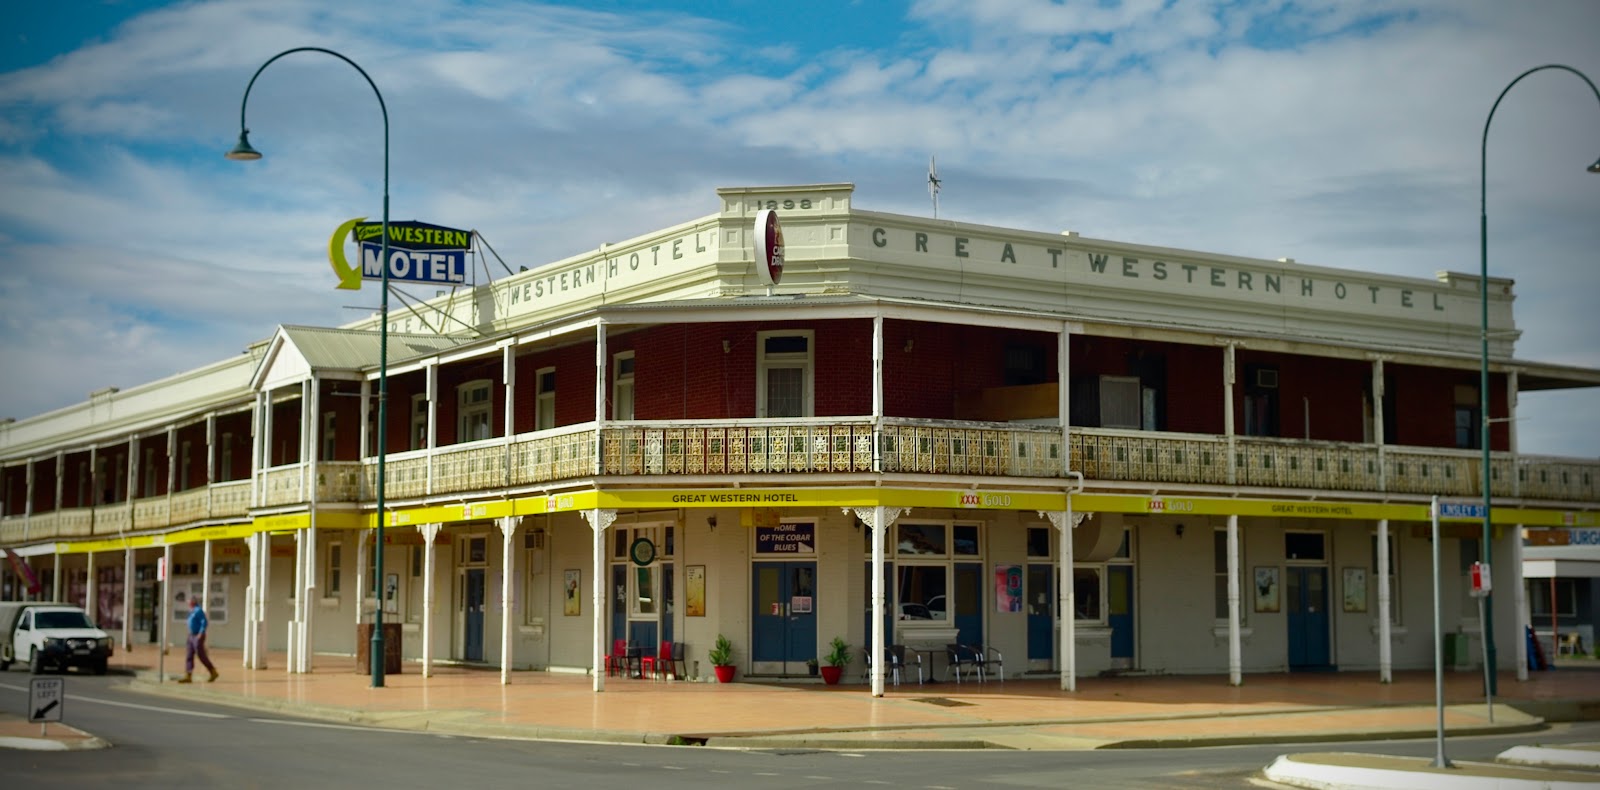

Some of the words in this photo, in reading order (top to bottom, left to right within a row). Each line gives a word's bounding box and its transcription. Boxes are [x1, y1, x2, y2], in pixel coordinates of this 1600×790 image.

[757, 199, 813, 210] 1898
[388, 226, 468, 246] WESTERN
[364, 249, 464, 282] MOTEL
[511, 264, 595, 306] WESTERN
[609, 233, 706, 278] HOTEL
[871, 227, 1063, 268] GREAT
[1088, 253, 1281, 294] WESTERN
[1301, 279, 1444, 312] HOTEL
[672, 494, 706, 503] GREAT
[709, 494, 760, 503] WESTERN
[764, 493, 798, 502] HOTEL
[960, 494, 981, 505] XXXX
[984, 494, 1011, 506] GOLD
[1272, 504, 1294, 513] GREAT
[1296, 505, 1330, 514] WESTERN
[1331, 507, 1353, 515] HOTEL
[760, 534, 770, 542] OF
[786, 534, 811, 542] COBAR
[774, 543, 797, 552] BLUES
